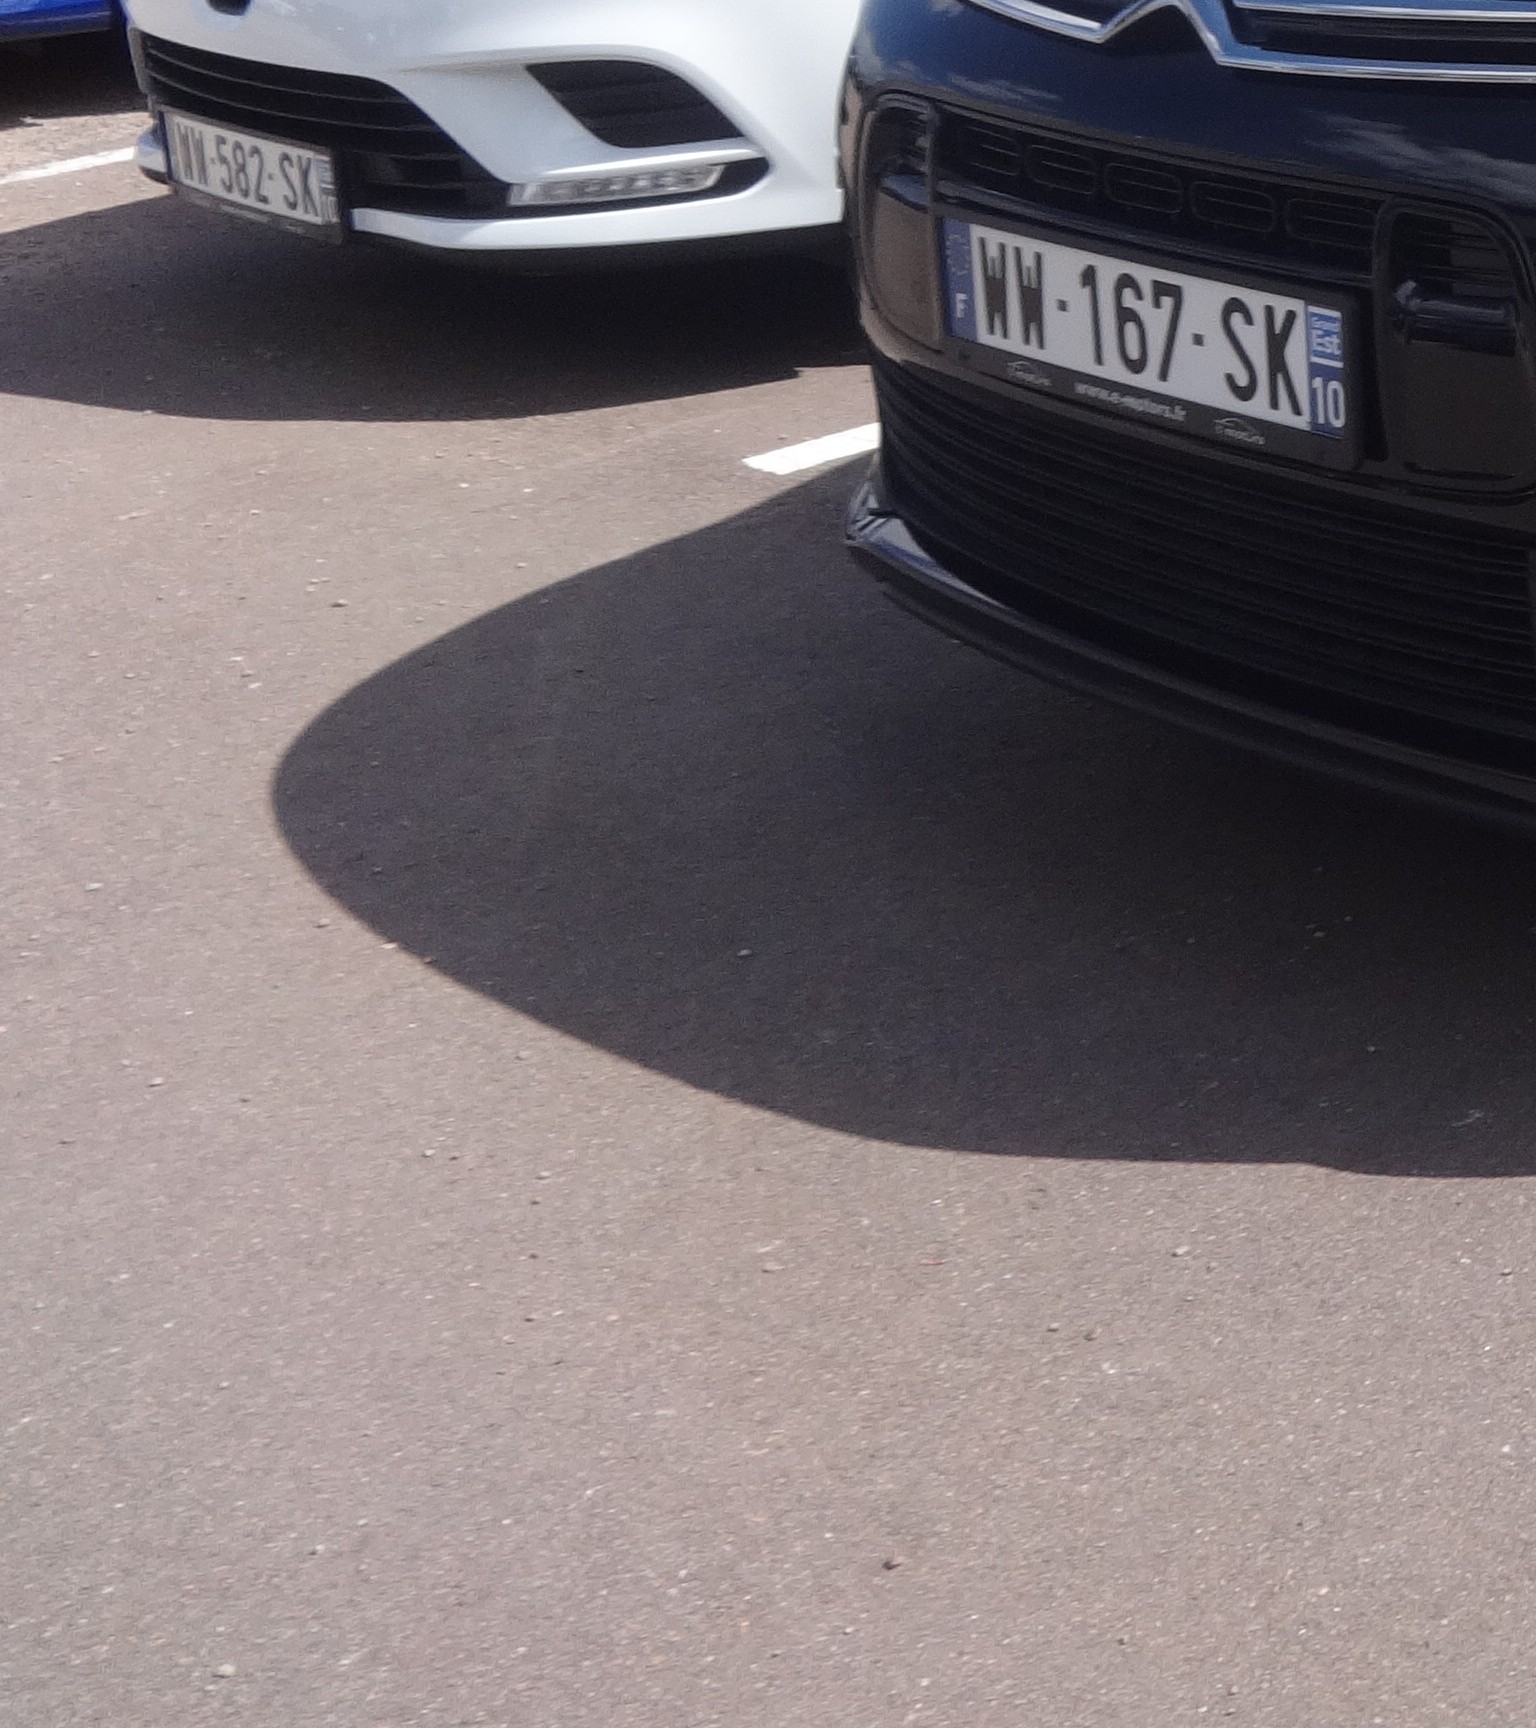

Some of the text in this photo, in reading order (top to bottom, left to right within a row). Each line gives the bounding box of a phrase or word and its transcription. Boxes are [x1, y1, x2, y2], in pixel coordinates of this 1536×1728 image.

[955, 292, 969, 319] F
[979, 236, 1303, 416] WW-167-SK
[1311, 376, 1346, 429] 10
